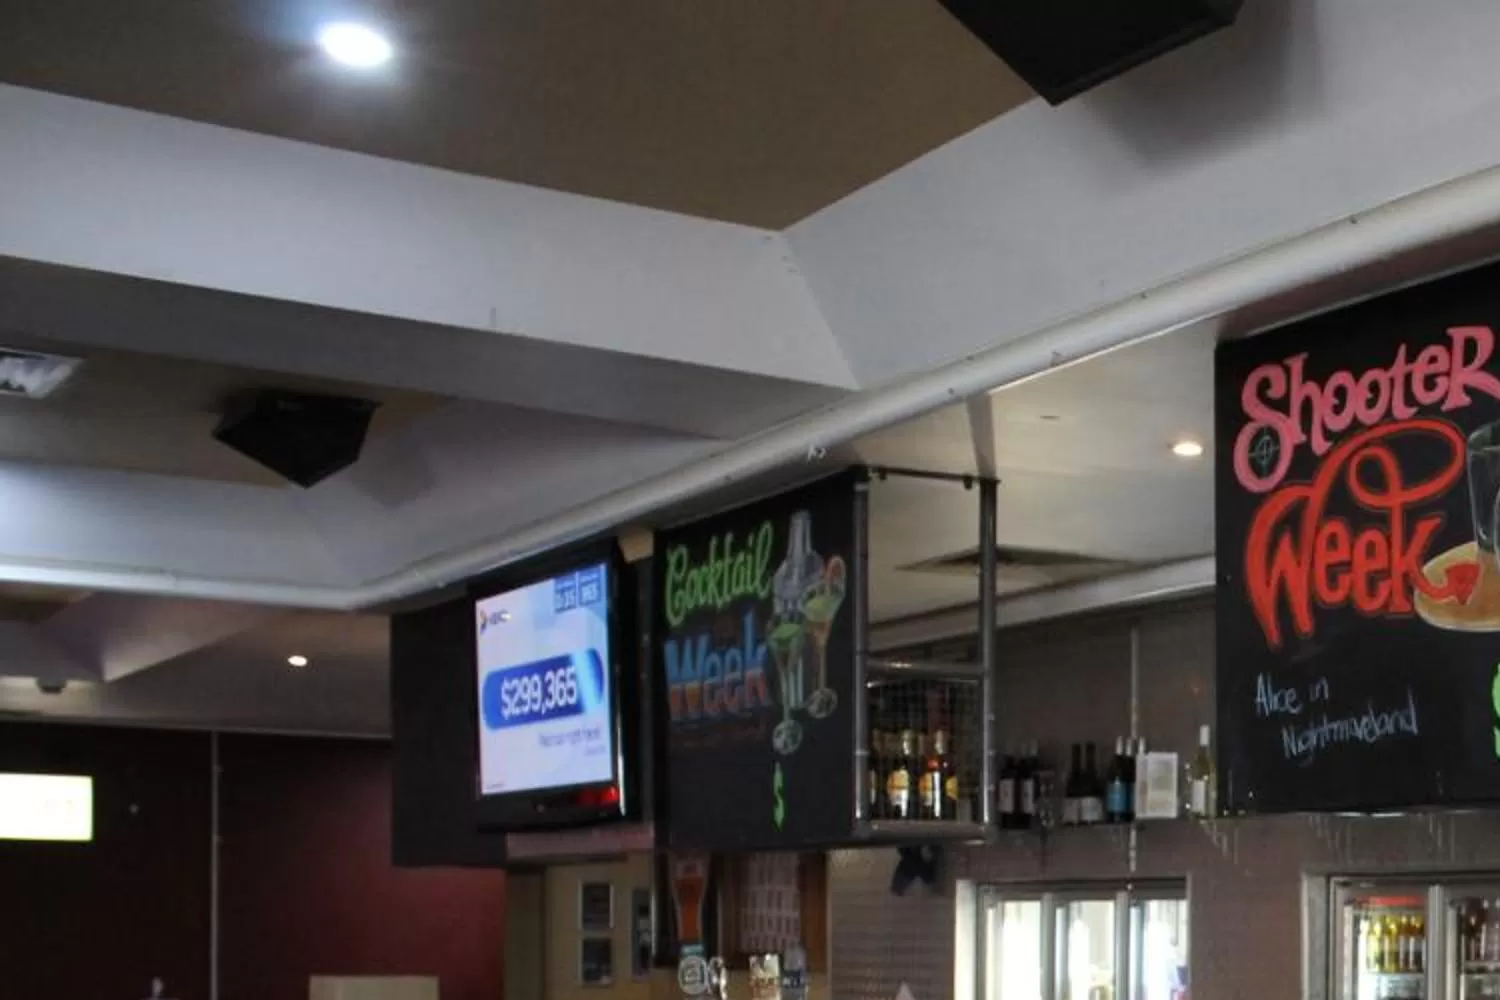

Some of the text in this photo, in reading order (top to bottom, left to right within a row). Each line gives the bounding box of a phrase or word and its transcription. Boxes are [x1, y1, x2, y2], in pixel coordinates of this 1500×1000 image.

[664, 520, 774, 627] Cocktail
[1245, 417, 1475, 655] Week
[501, 665, 578, 720] $299,365
[664, 606, 769, 721] Week
